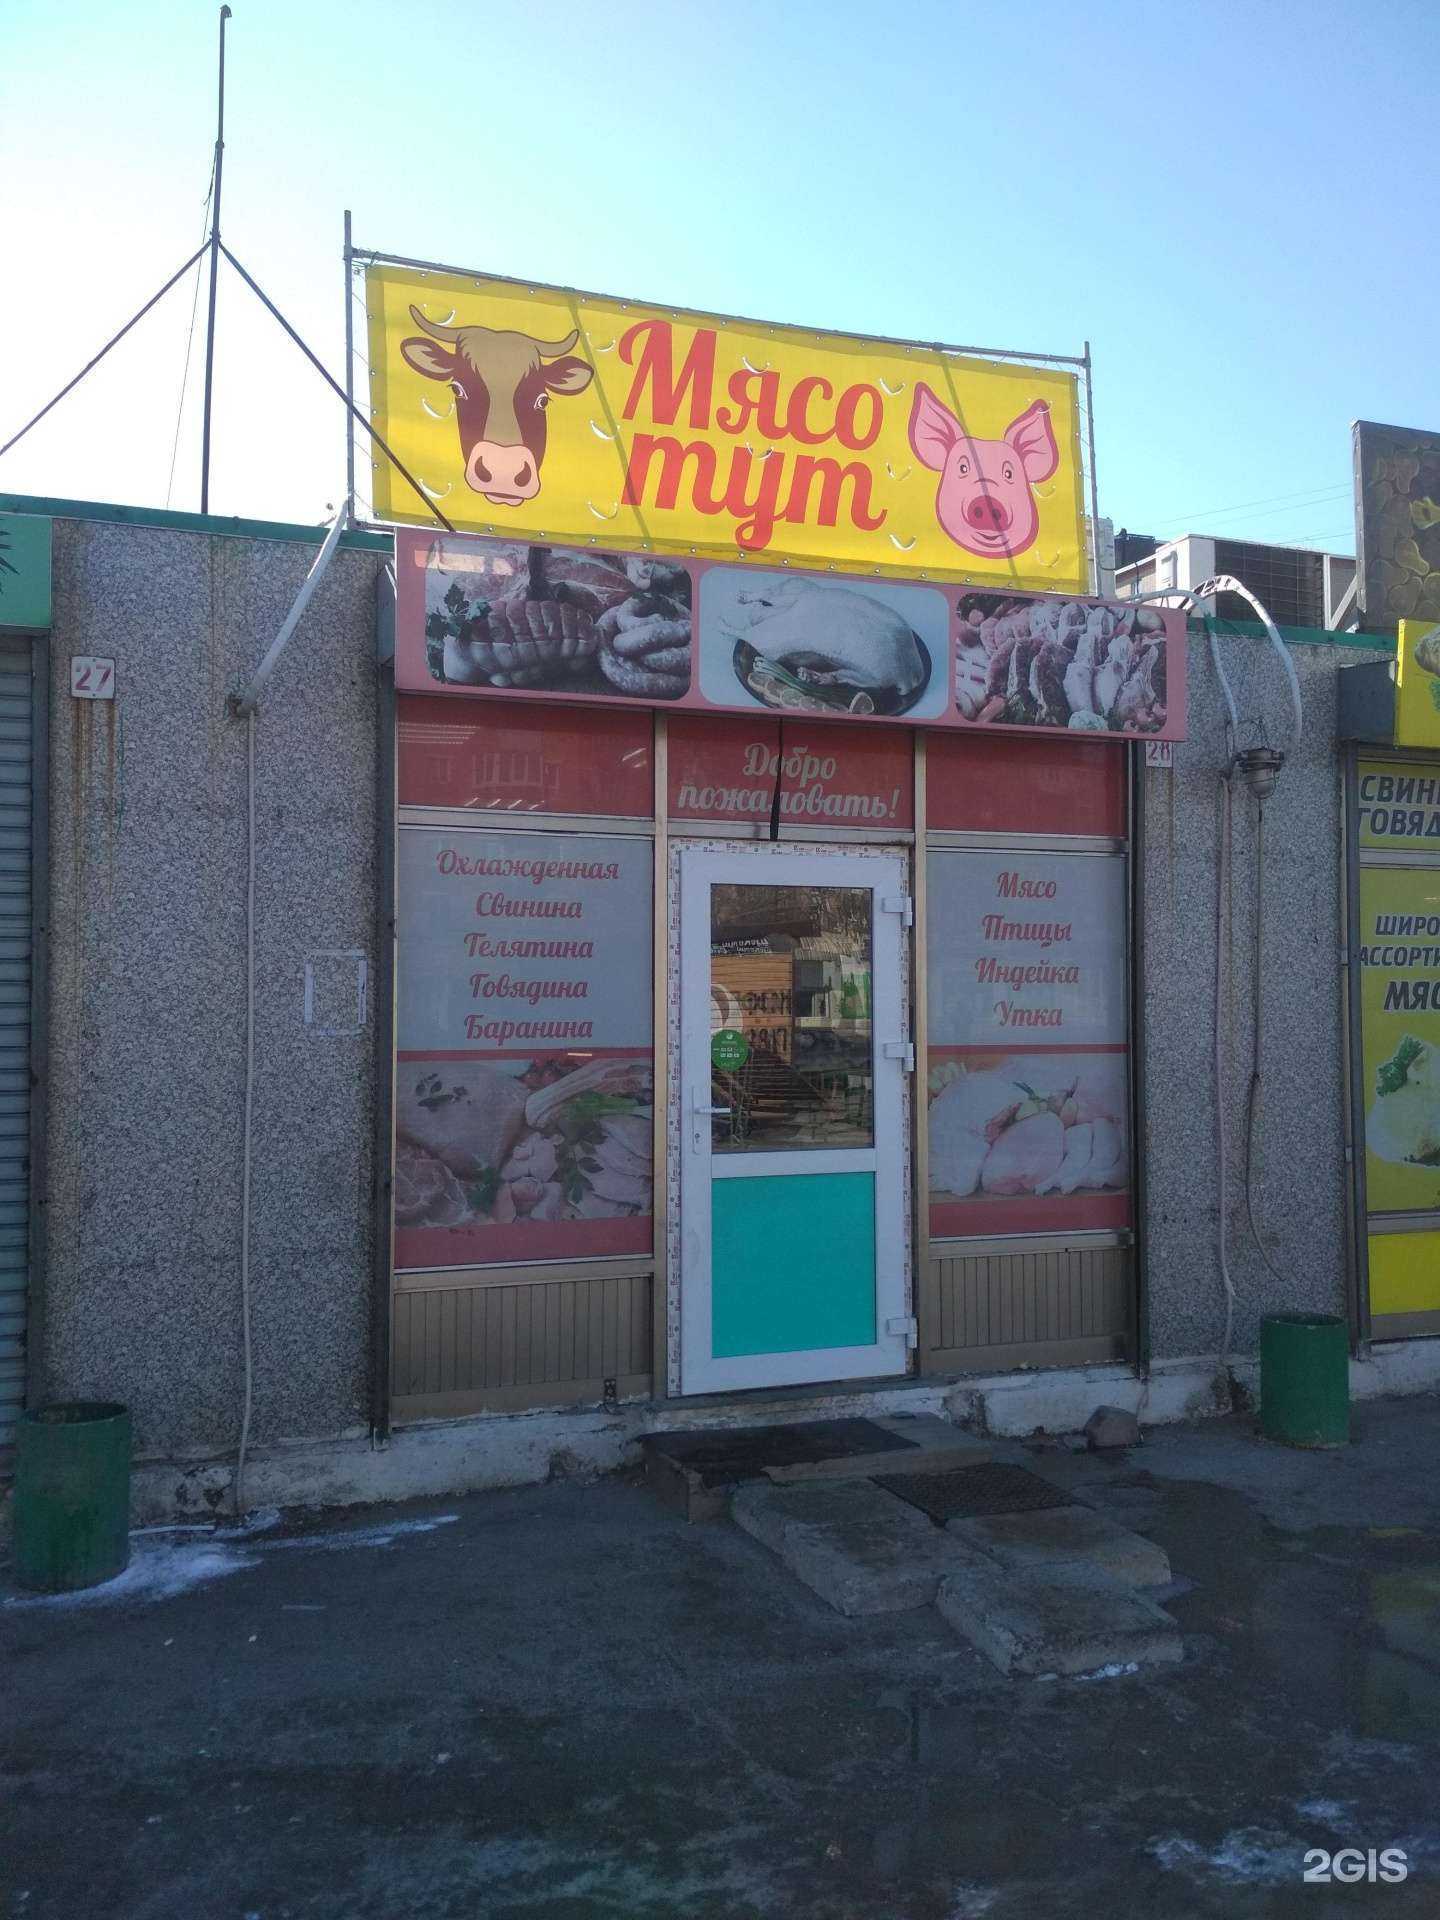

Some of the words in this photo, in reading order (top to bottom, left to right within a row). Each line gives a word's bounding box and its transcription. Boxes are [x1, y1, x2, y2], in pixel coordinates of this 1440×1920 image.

[618, 319, 885, 451] Мясо
[620, 431, 888, 552] тут
[75, 662, 112, 692] 27
[742, 742, 837, 788] Добро
[436, 849, 620, 885] Охлажденная
[997, 871, 1057, 898] Мясо
[475, 891, 583, 919] Свинина
[463, 932, 594, 959] Телятина
[982, 914, 1073, 949] Птицы
[469, 973, 591, 1006] Говядина
[974, 957, 1081, 992] Индейка
[463, 1014, 593, 1046] Баранина
[993, 1000, 1063, 1027] Утка
